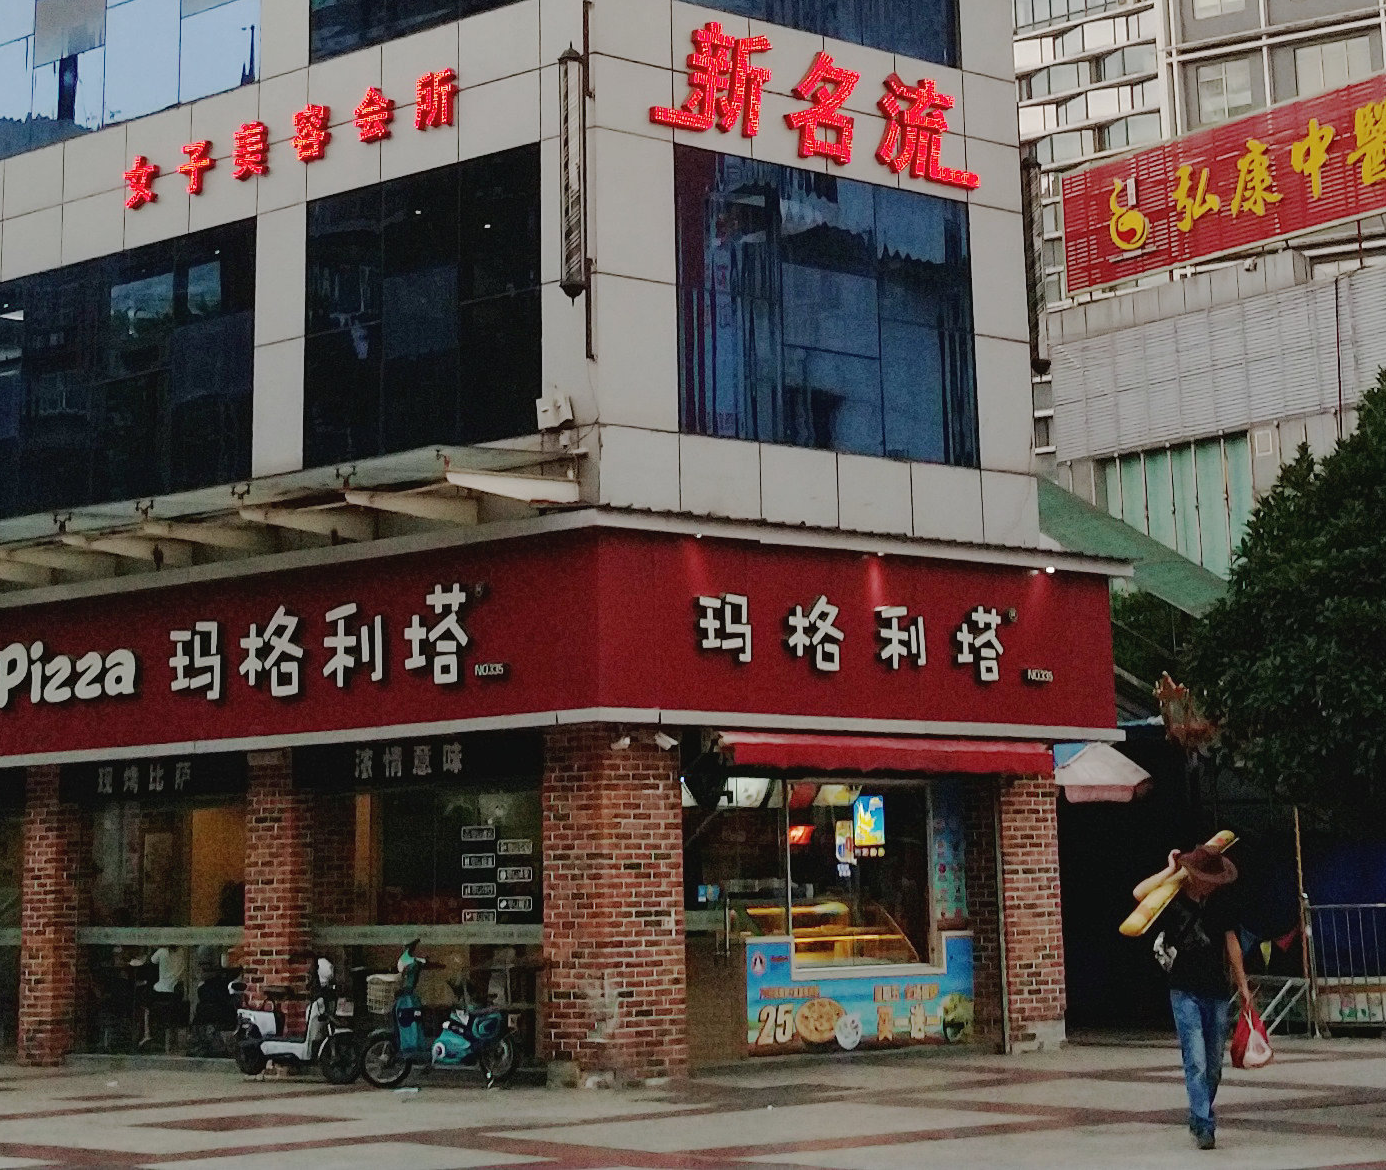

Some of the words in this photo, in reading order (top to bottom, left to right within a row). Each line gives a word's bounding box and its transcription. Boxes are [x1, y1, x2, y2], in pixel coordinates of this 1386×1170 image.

[124, 67, 457, 209] 女子美容会所
[649, 20, 979, 190] 新名流
[168, 582, 470, 700] 玛格利塔
[697, 593, 1004, 681] 玛格利塔
[353, 740, 464, 779] 浓情意味
[757, 1003, 794, 1046] 25
